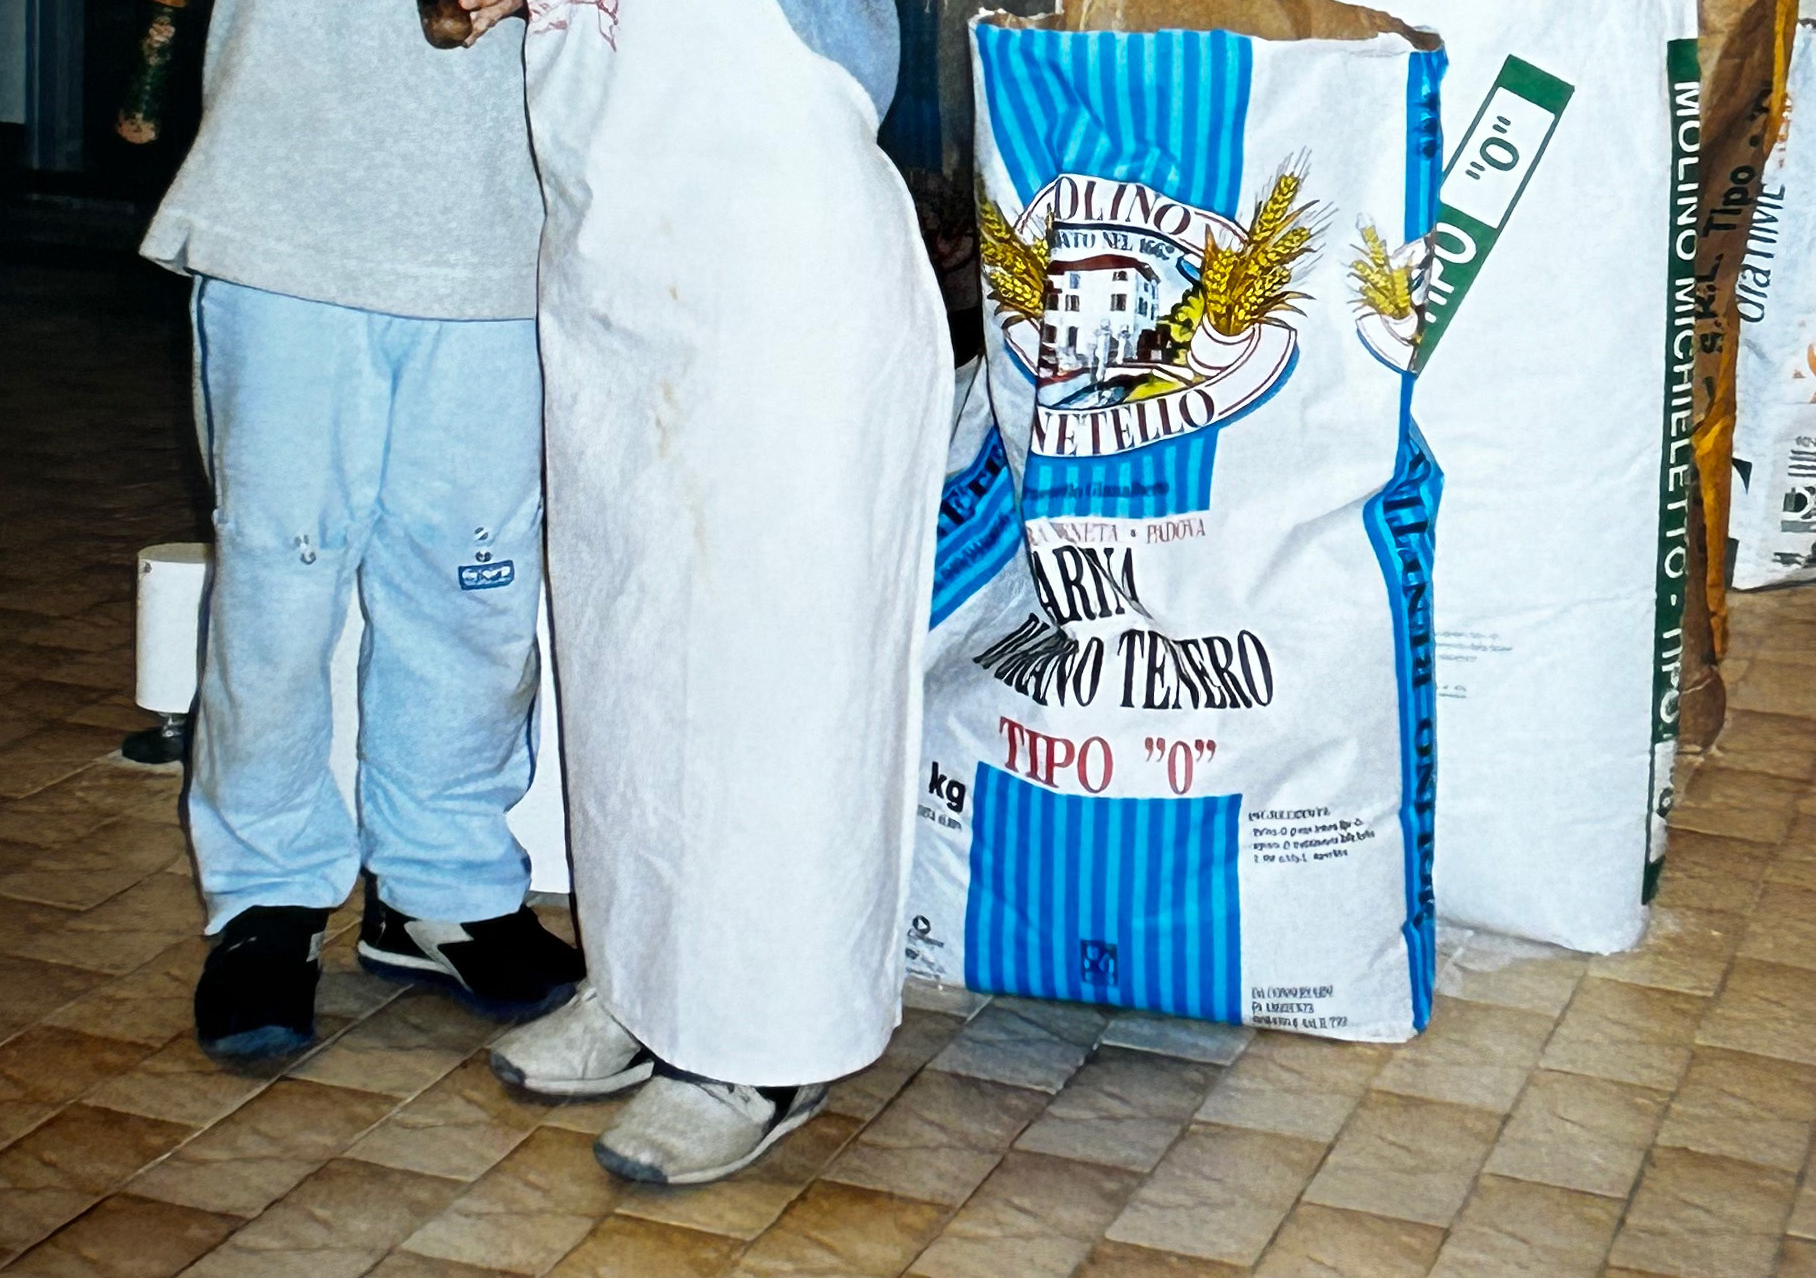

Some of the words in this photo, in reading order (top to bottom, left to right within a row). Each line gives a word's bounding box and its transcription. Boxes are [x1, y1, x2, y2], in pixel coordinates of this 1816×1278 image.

[1055, 176, 1192, 236] OLINO
[1032, 389, 1215, 457] NETELLO
[1118, 628, 1275, 710] TENERO
[928, 760, 966, 814] kg
[999, 715, 1113, 794] TIPO
